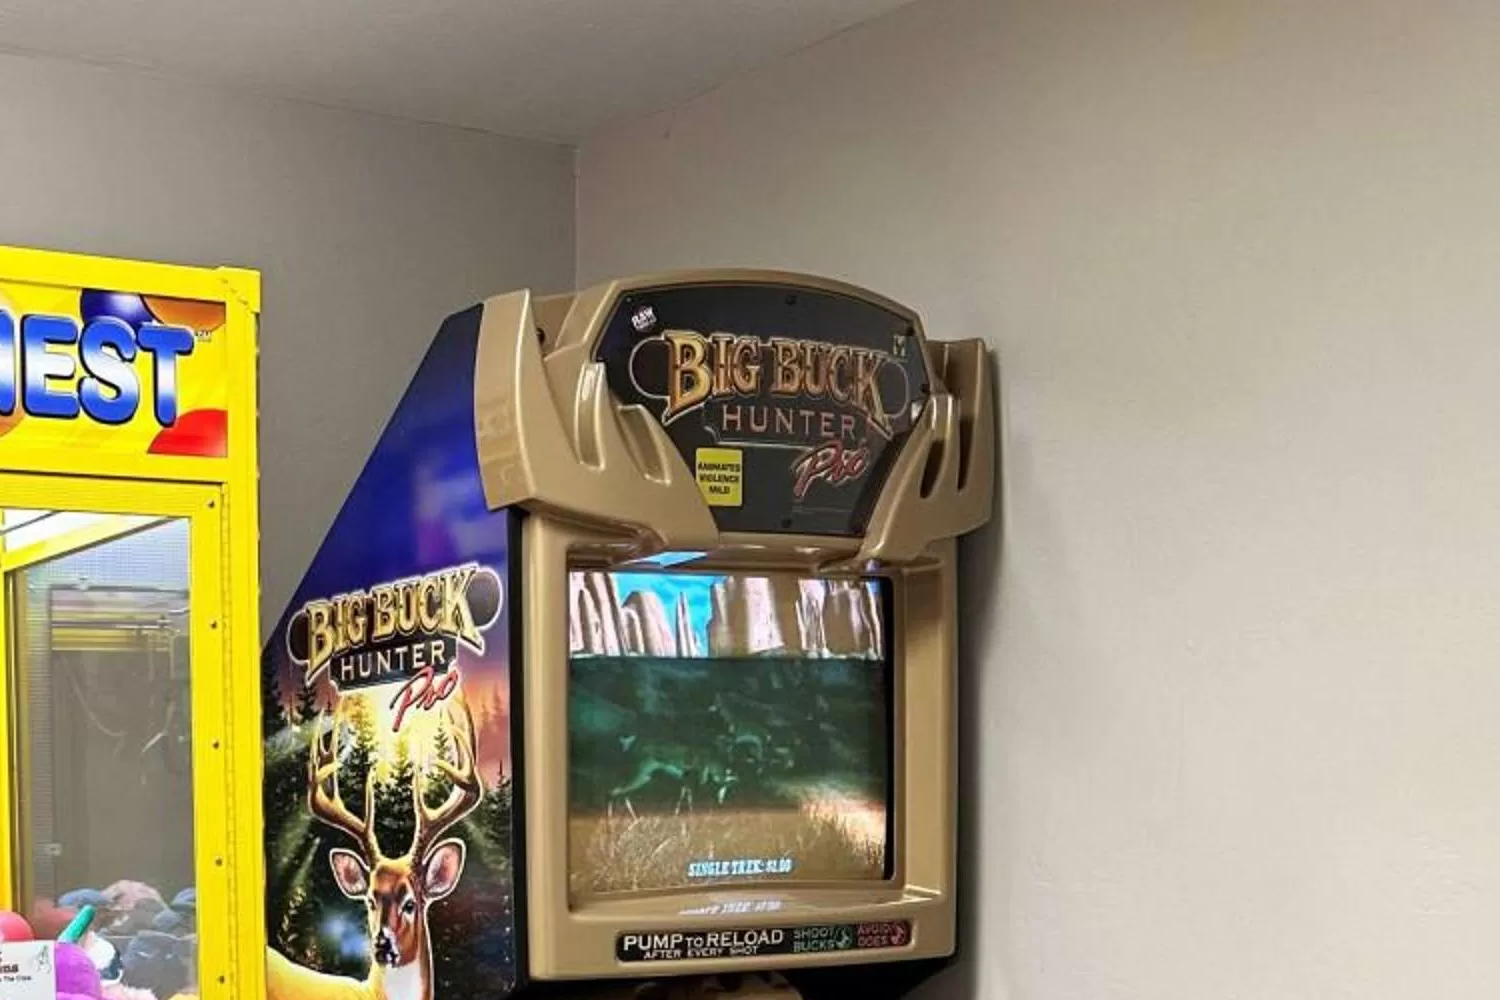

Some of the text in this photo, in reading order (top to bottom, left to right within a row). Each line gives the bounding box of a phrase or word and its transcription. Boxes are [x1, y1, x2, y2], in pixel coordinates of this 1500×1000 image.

[664, 331, 892, 438] BIG BUCK
[721, 404, 856, 440] HUNTER
[699, 473, 740, 483] VIOLENCE
[708, 485, 731, 495] MILD
[305, 565, 483, 682] BIG BUCK
[341, 640, 446, 681] HUNTER
[687, 861, 730, 877] SINGLE
[623, 933, 683, 951] PUMP
[706, 929, 784, 947] RELOAD
[793, 926, 836, 940] SHOOT
[643, 945, 759, 960] AFTER EVERY SHOT
